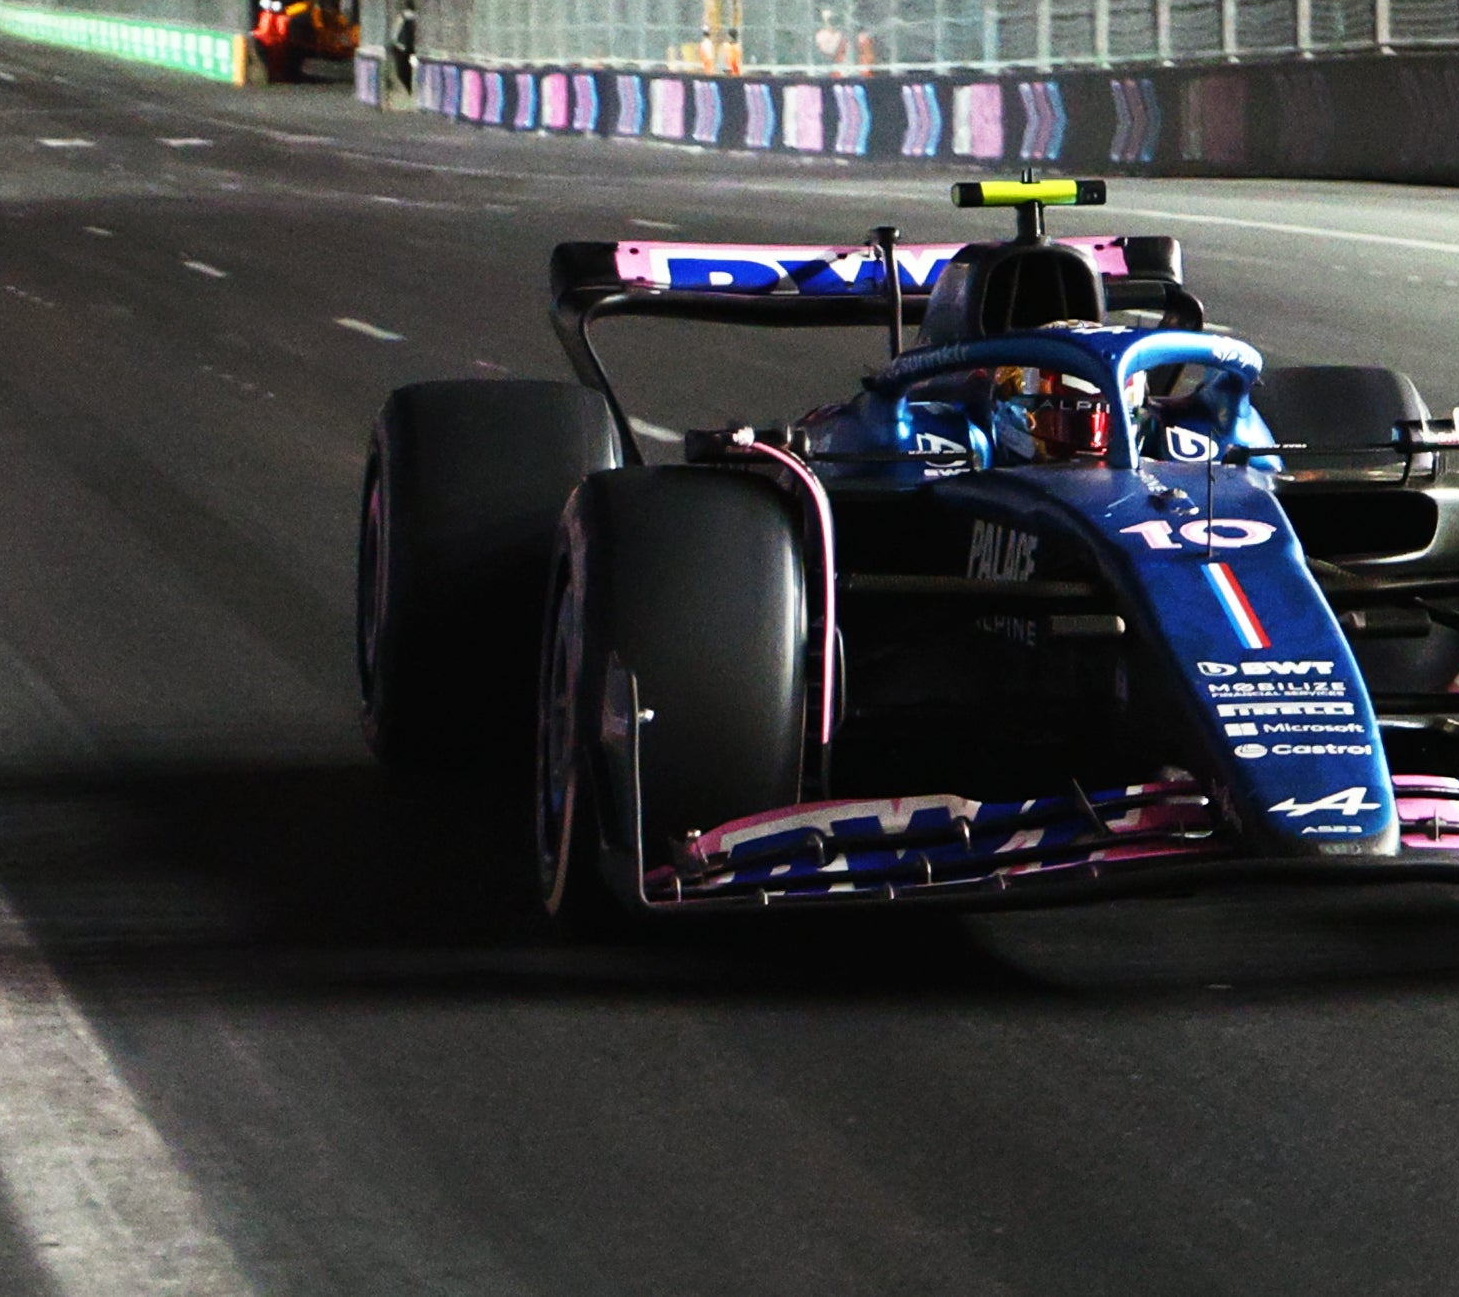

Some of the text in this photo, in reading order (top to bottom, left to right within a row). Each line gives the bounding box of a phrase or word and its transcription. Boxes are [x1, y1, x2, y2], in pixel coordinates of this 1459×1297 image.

[1119, 517, 1277, 549] 10
[1241, 661, 1334, 675] BWT
[1217, 702, 1355, 717] PIRELLI
[1263, 723, 1365, 733] Microsoft
[1272, 744, 1372, 755] Castrol
